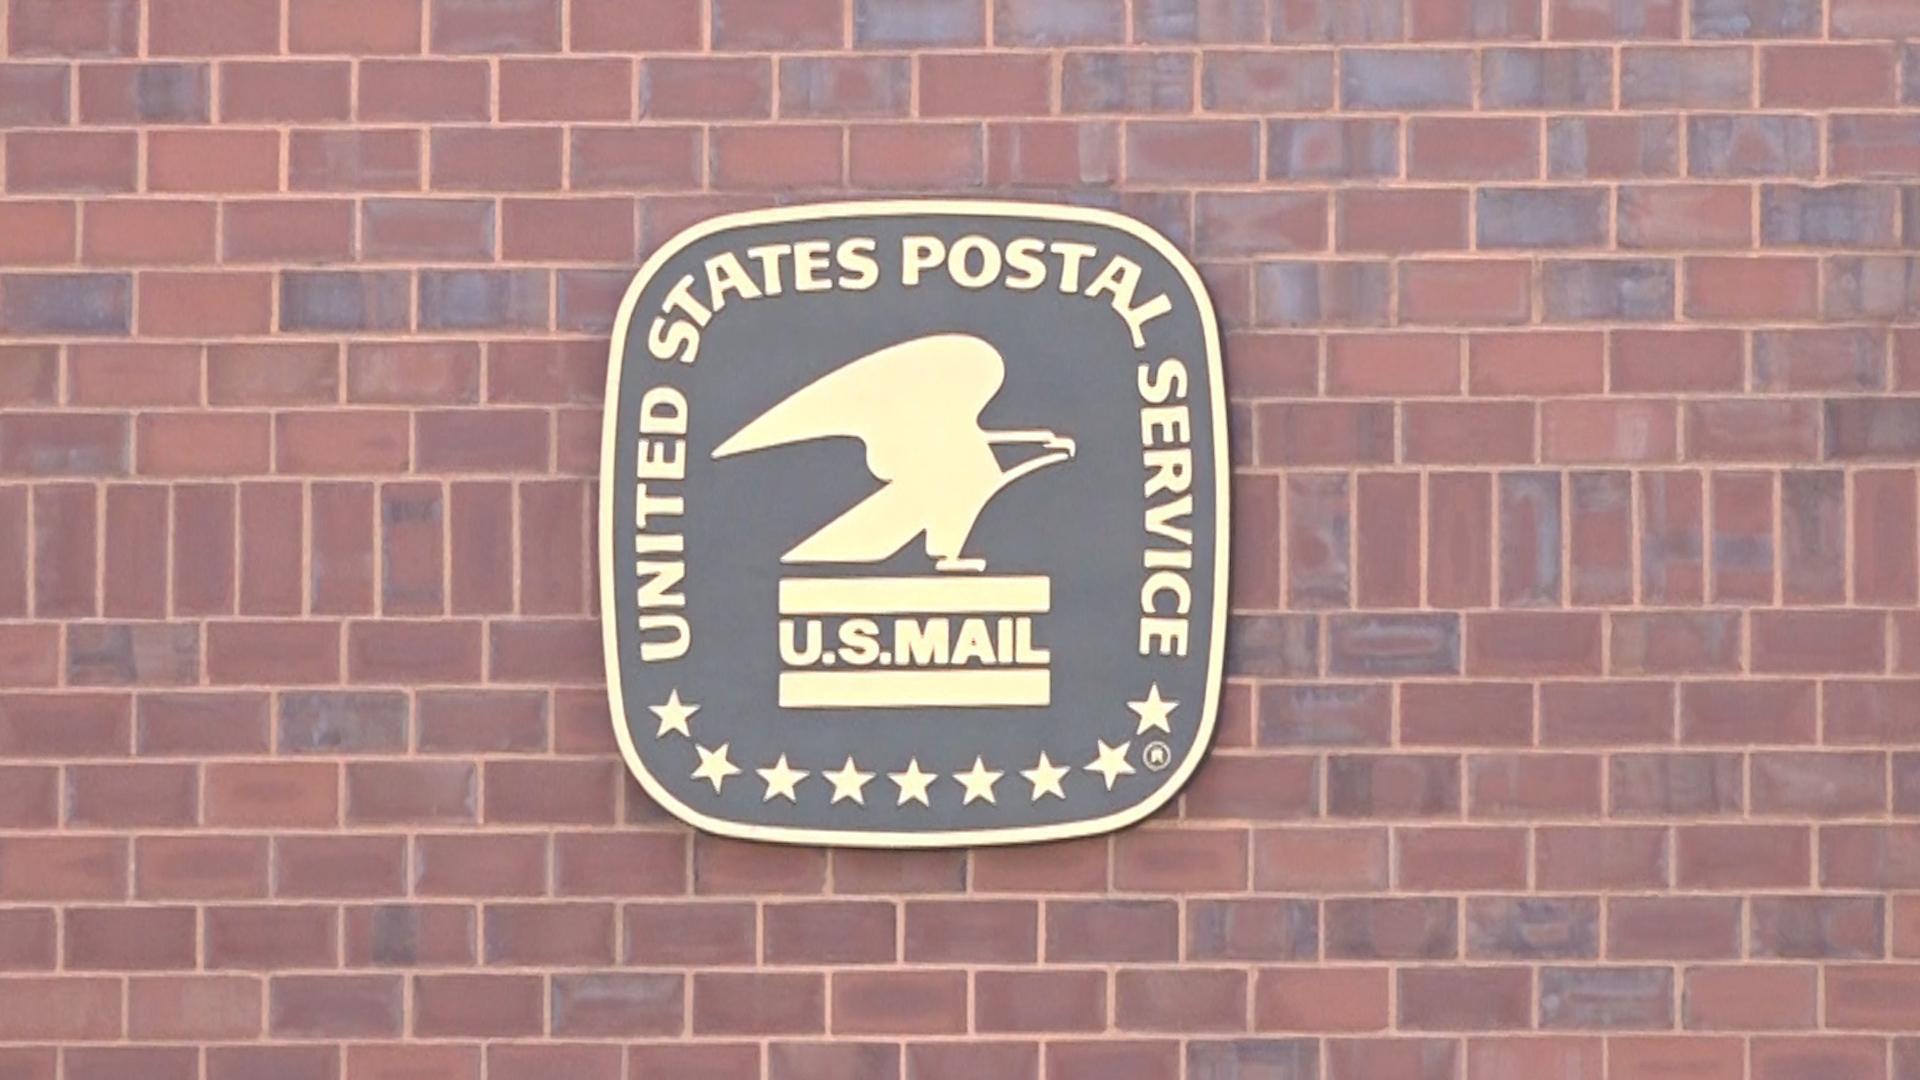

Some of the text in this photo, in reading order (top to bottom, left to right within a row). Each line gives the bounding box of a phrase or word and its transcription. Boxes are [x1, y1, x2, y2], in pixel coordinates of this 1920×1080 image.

[636, 236, 1193, 662] UNITED STATES POSTAL SERVICE
